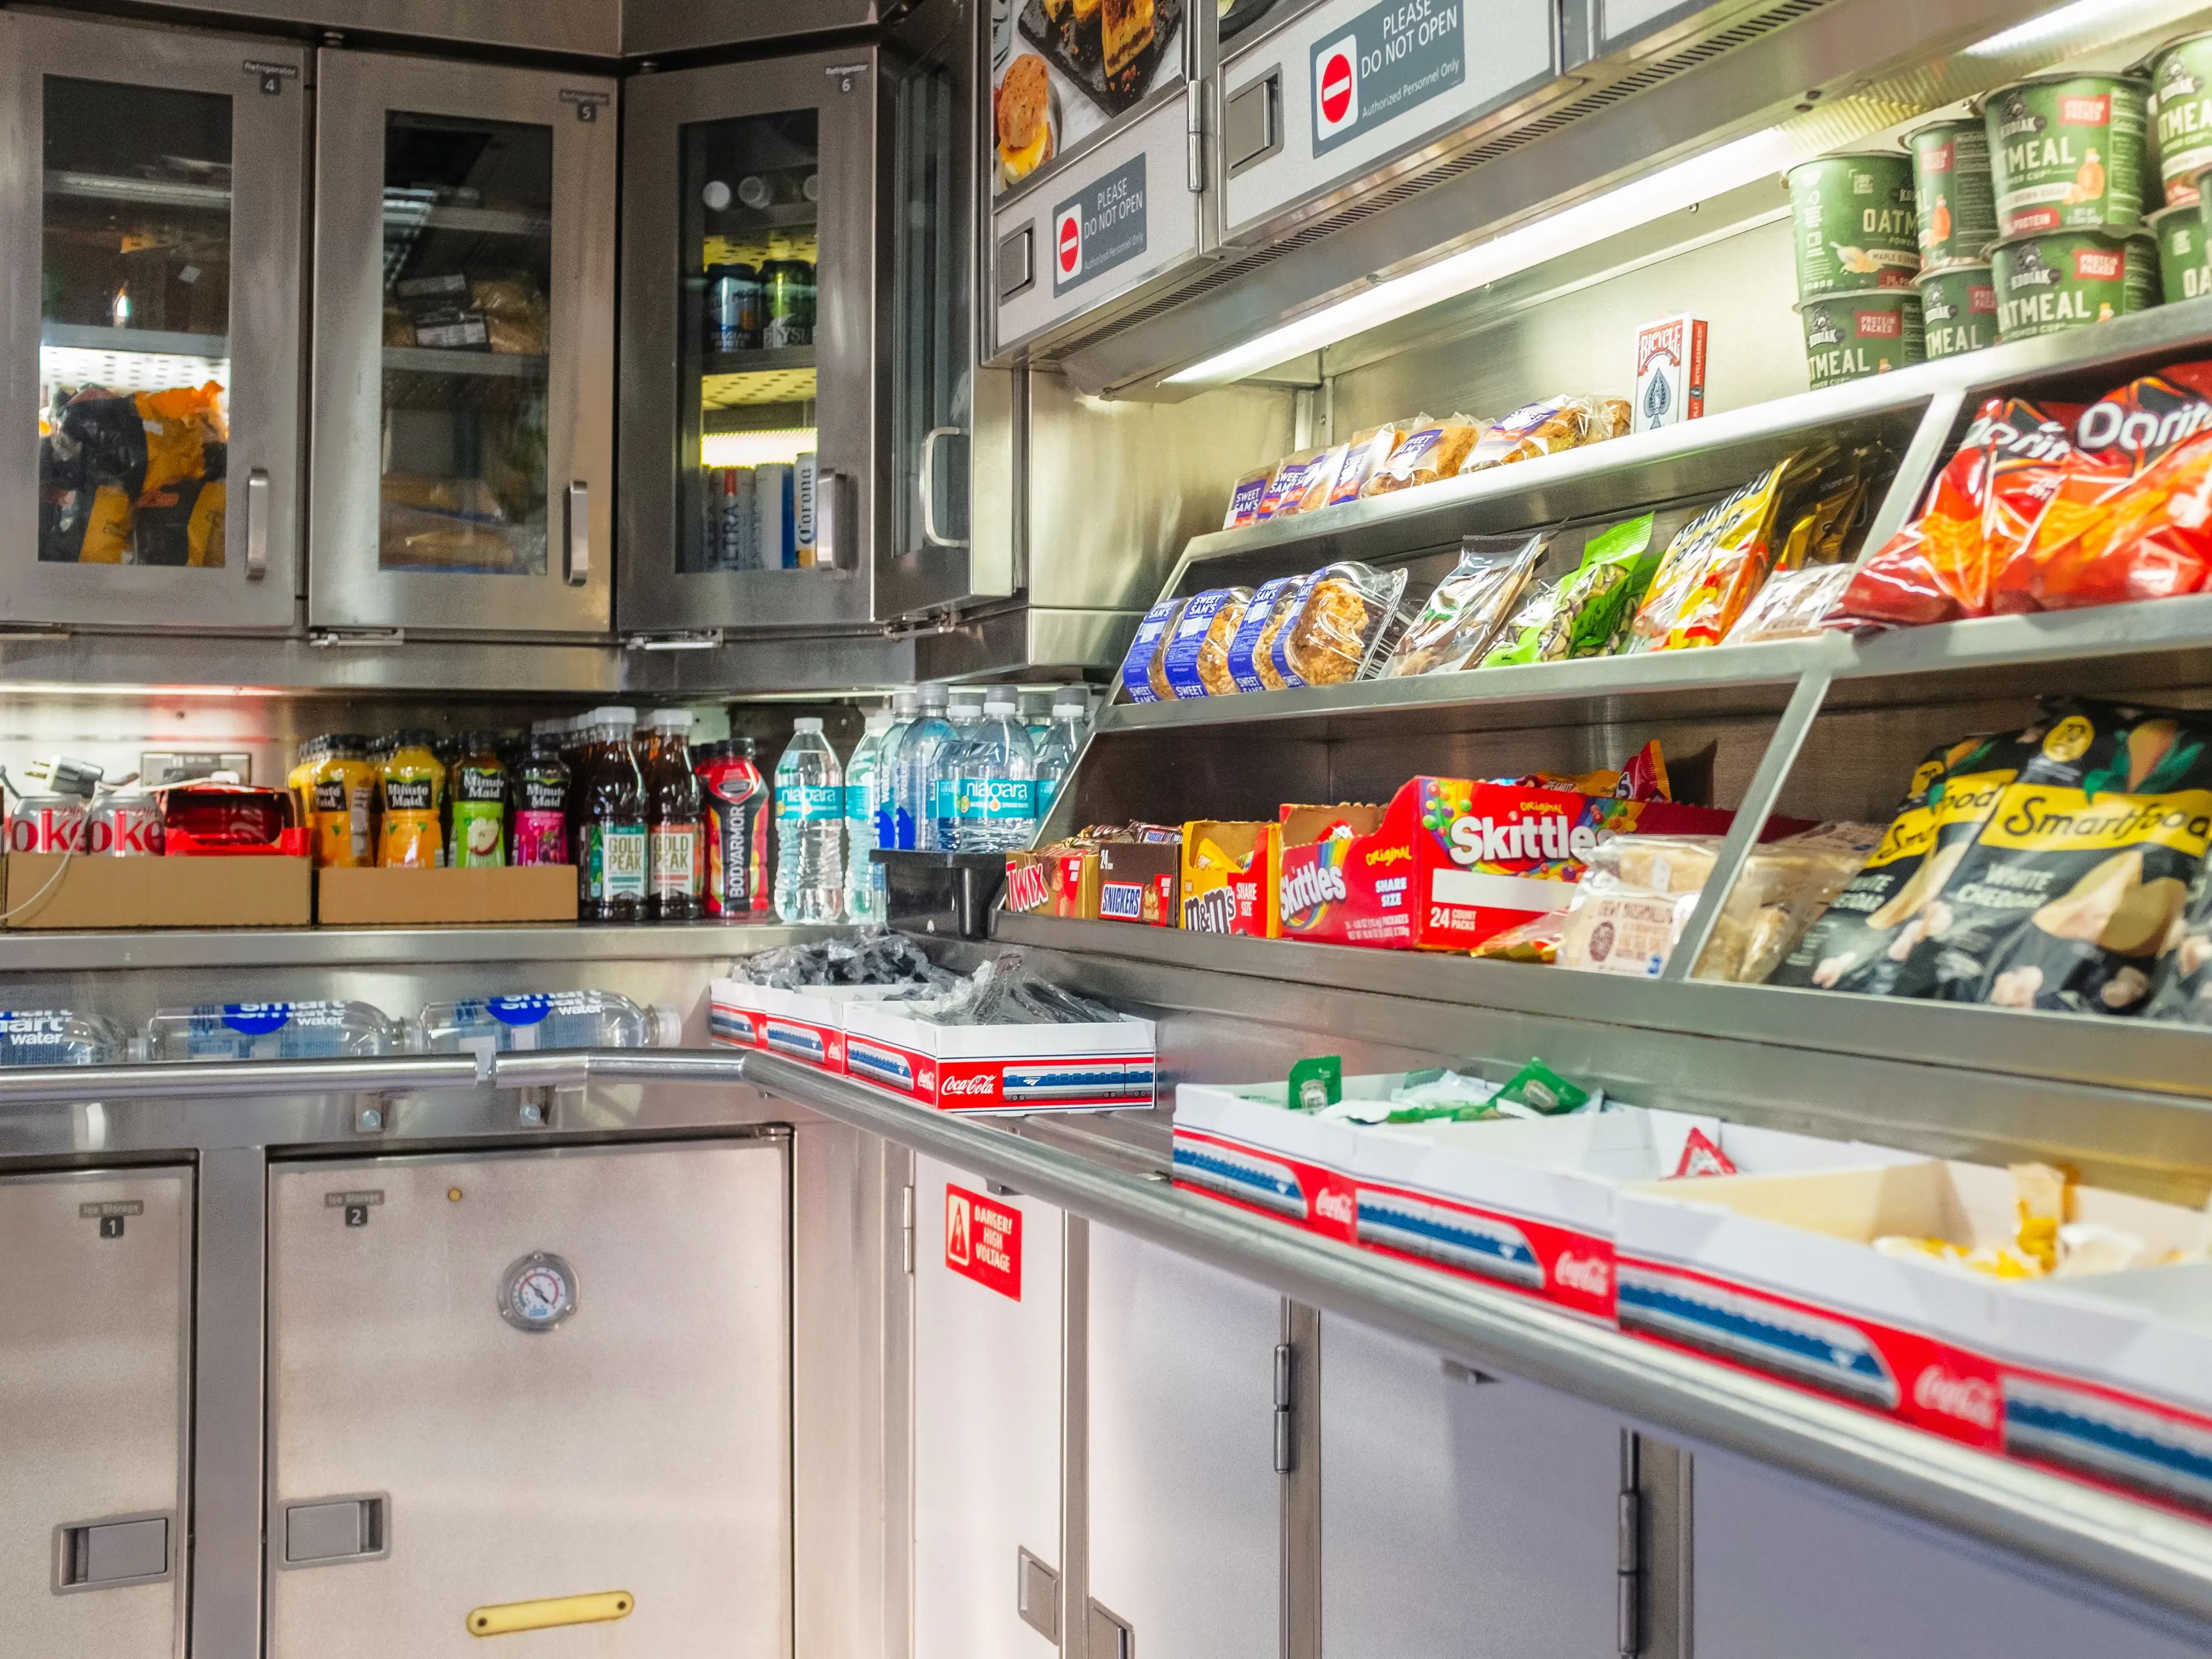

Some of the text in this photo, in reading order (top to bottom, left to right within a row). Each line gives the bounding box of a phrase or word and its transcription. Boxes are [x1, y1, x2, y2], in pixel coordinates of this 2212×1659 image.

[1384, 0, 1431, 39] PLEASE
[1361, 5, 1457, 79] DO NOT OPEN
[265, 79, 275, 92] 4
[842, 78, 851, 92] 6
[1362, 58, 1460, 119] Authorized Personnel Only
[582, 106, 592, 119] 5
[1097, 177, 1127, 210] PLEASE
[1084, 191, 1143, 240] DO NOT OPEN
[1084, 251, 1108, 272] Authorized
[1109, 238, 1131, 257] Personnel
[1132, 232, 1144, 246] Only
[2080, 254, 2118, 266] PROTEIN
[2080, 264, 2115, 276] PACKED
[1861, 316, 1896, 325] PROTEIN
[1861, 324, 1892, 334] PACKED
[1639, 324, 1682, 373] BICYCLE
[1236, 487, 1261, 500] SWEET
[797, 468, 815, 545] Corona
[1234, 499, 1259, 513] SAM'S
[1261, 581, 1286, 592] SWEET
[1298, 585, 1313, 597] SAM'S
[1194, 594, 1223, 605] SWEET
[1254, 589, 1278, 602] SAM'S
[1156, 600, 1180, 609] SWEET
[1189, 604, 1217, 615] SAM'S
[1148, 608, 1171, 619] SAM'S
[1236, 676, 1260, 687] SWEET
[1129, 686, 1152, 697] SWEET
[1176, 685, 1204, 696] SWEET
[463, 774, 505, 789] Minute
[881, 765, 890, 804] water
[900, 760, 909, 801] water
[387, 783, 429, 797] Minute
[468, 786, 501, 798] Maid
[526, 783, 565, 797] Minute
[967, 782, 1028, 798] niagara
[392, 794, 425, 808] Maid
[531, 795, 561, 808] Maid
[608, 836, 642, 854] GOLD
[654, 836, 689, 852] GOLD
[729, 805, 745, 898] BODYARMOR
[608, 854, 642, 871] PEAK
[654, 853, 688, 869] PEAK
[1100, 850, 1109, 870] 24
[1375, 877, 1407, 893] SHARE
[1985, 863, 2056, 891] WHITE
[1236, 882, 1257, 902] SHARE
[1281, 861, 1347, 922] Skittles
[1103, 886, 1141, 915] SNICKERS
[1381, 892, 1402, 908] SIZE
[1240, 902, 1253, 916] SIZE
[1451, 908, 1477, 921] COUNT
[1429, 907, 1450, 929] 24
[1450, 919, 1476, 931] PACKS
[558, 1004, 602, 1015] water
[297, 1016, 344, 1026] water
[10, 1032, 63, 1045] water
[918, 1068, 935, 1092] Coca-Cola
[941, 1074, 997, 1096] Coca-Cola
[1316, 1187, 1353, 1225] Coca-Cola
[351, 1208, 361, 1224] 2
[974, 1205, 1013, 1235] DANGER!
[108, 1219, 116, 1235] 1
[983, 1227, 1003, 1250] HIGH
[975, 1242, 1011, 1274] VOLTAGE
[1555, 1250, 1609, 1297] Coca-Cola
